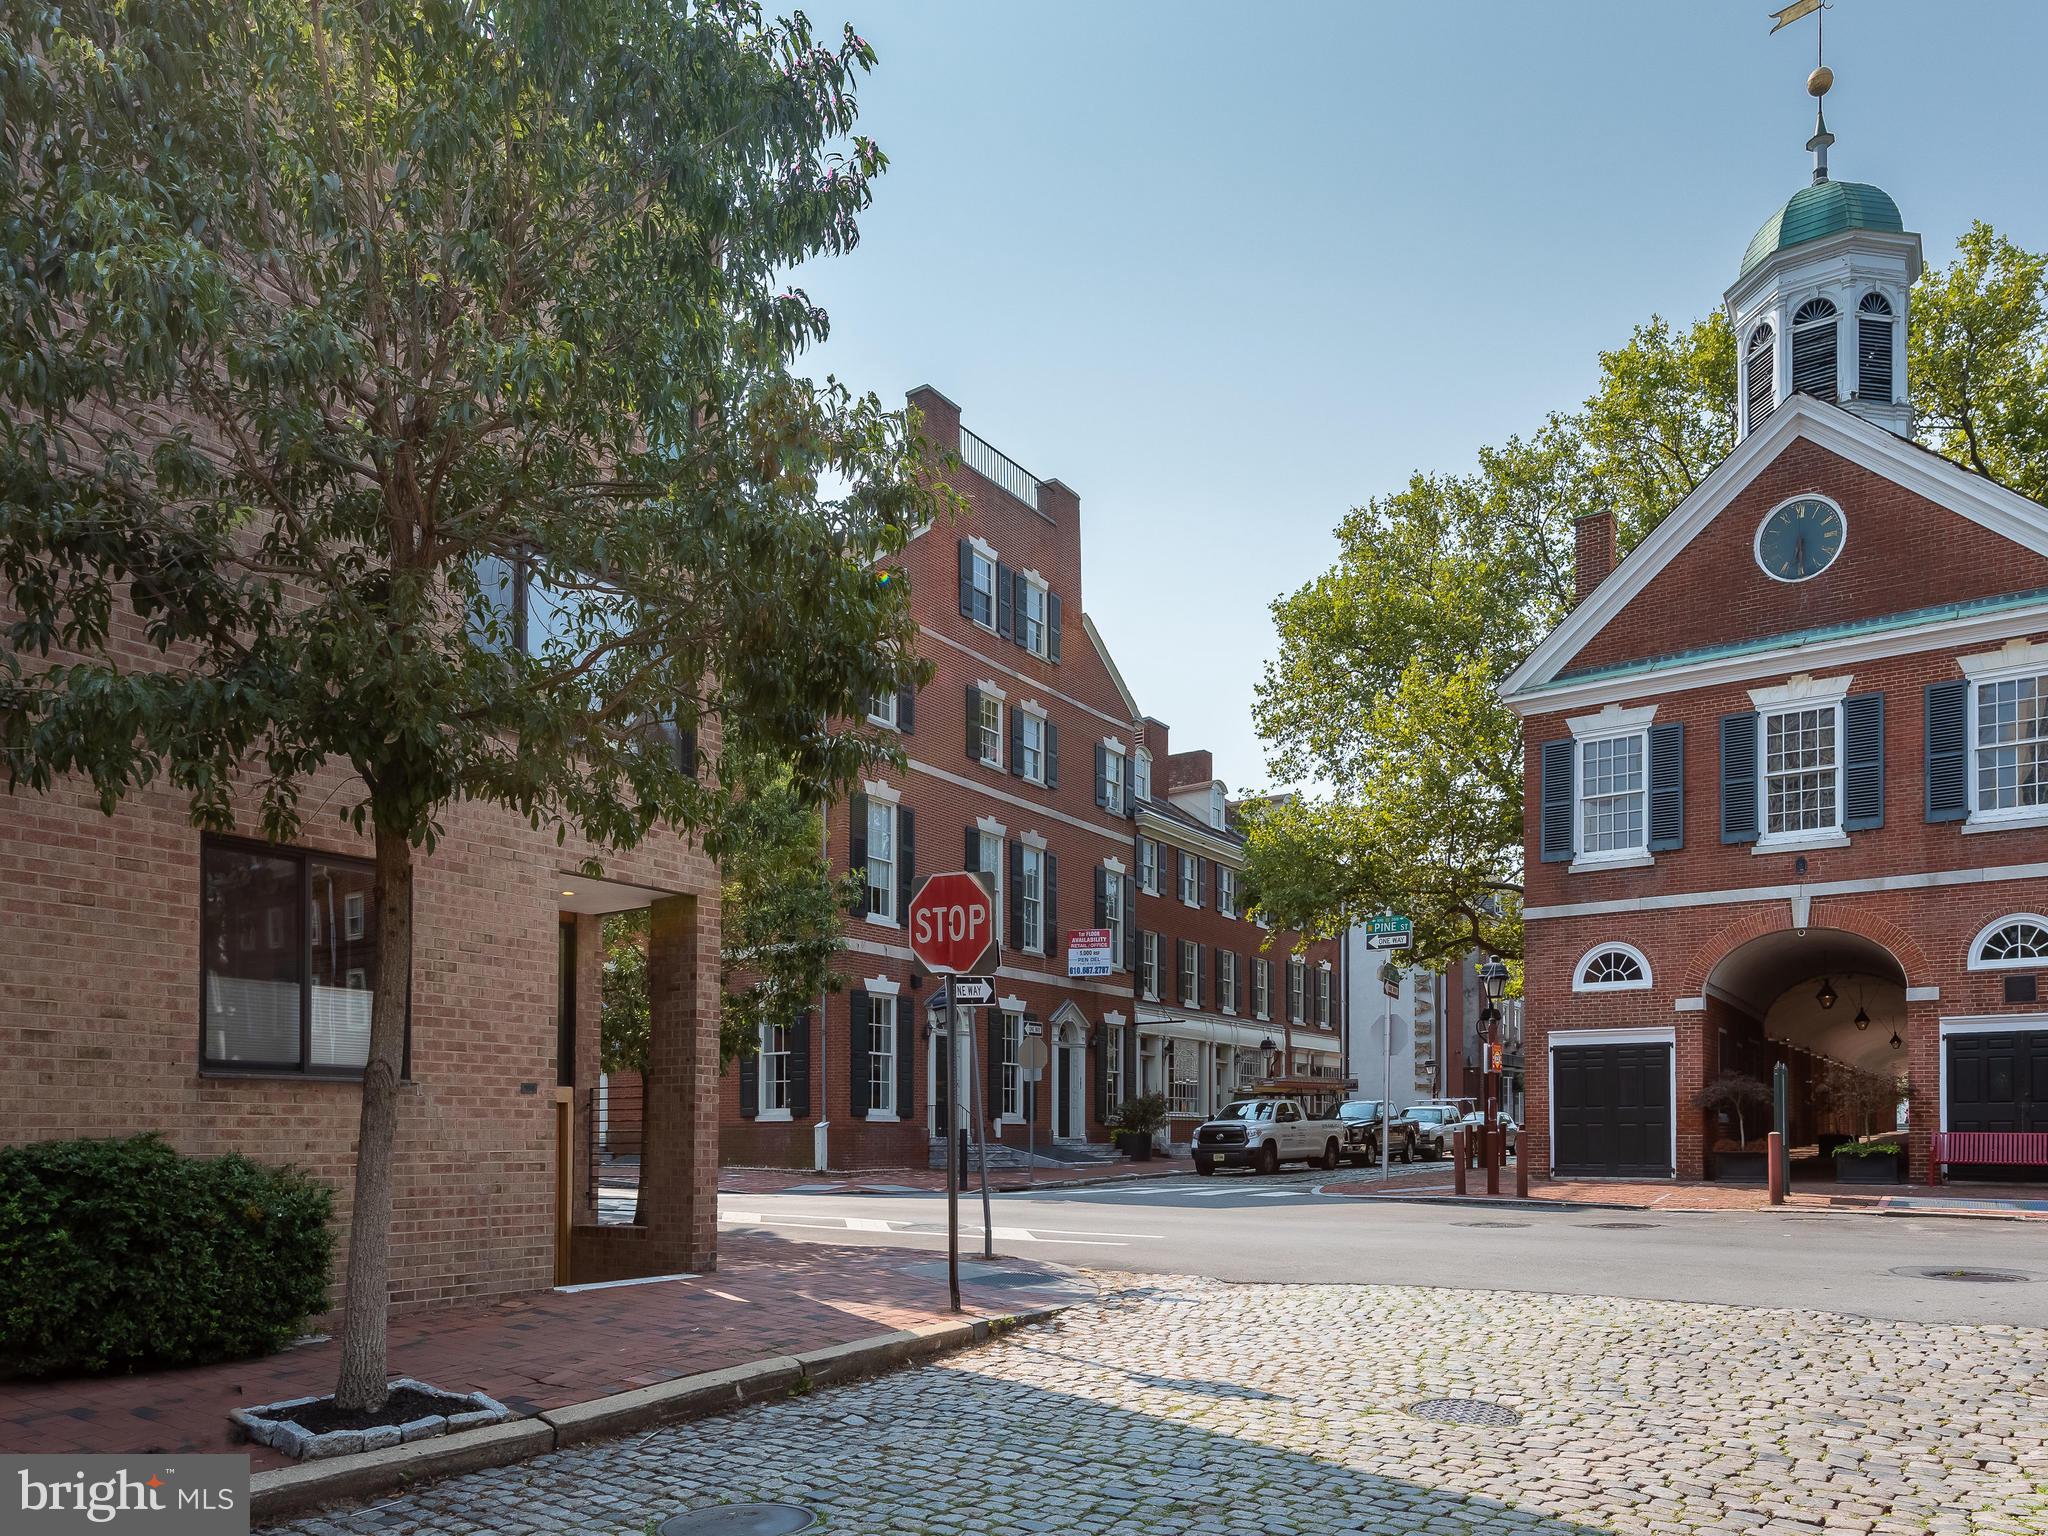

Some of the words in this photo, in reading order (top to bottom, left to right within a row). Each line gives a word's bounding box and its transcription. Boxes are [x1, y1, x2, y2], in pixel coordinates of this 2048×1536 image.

[915, 904, 986, 944] STOP
[1374, 922, 1397, 932] PINE
[1378, 937, 1391, 945] ONE
[1392, 936, 1405, 944] WAY
[957, 985, 966, 996] NE
[968, 985, 982, 996] WAY
